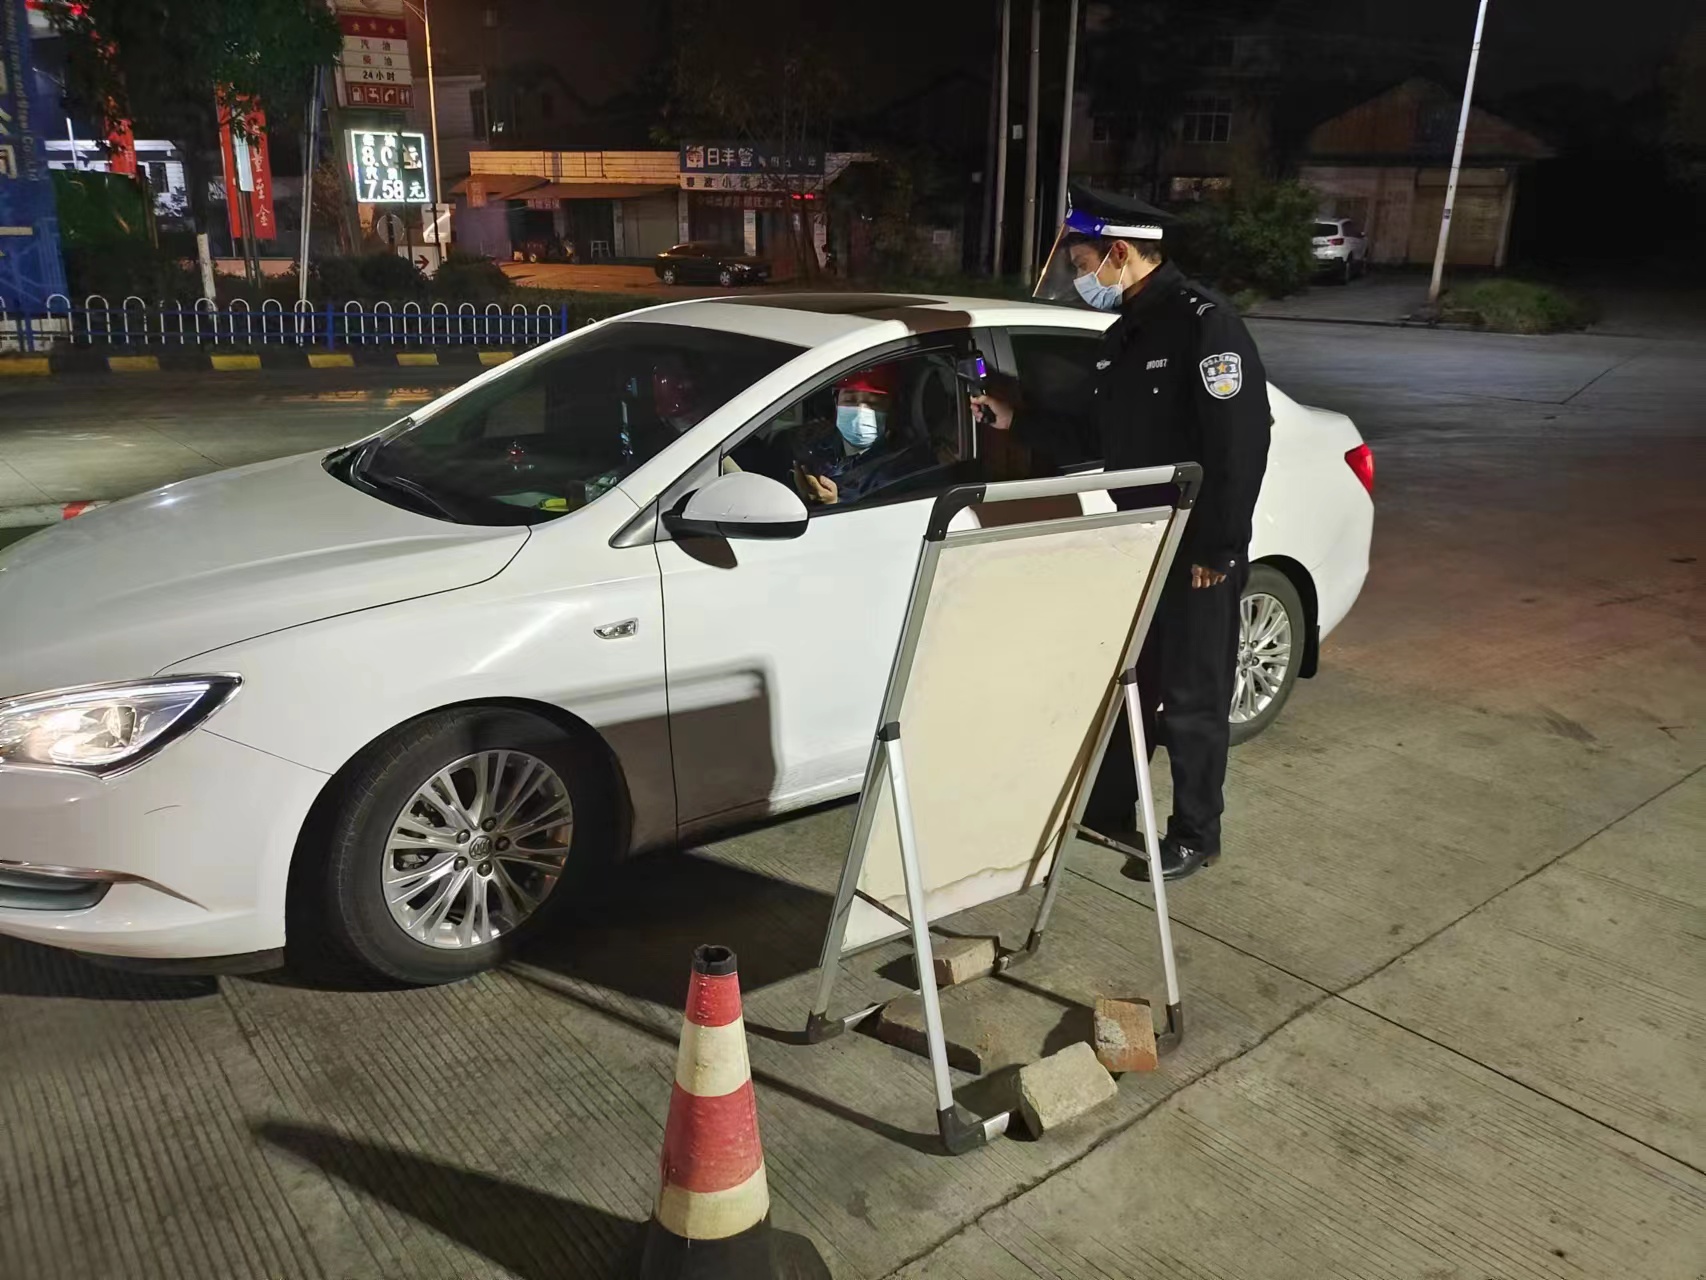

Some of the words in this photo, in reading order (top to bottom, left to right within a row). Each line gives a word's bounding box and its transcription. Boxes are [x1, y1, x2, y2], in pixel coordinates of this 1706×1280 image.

[363, 70, 395, 82] 24小时
[707, 147, 754, 168] 日丰管
